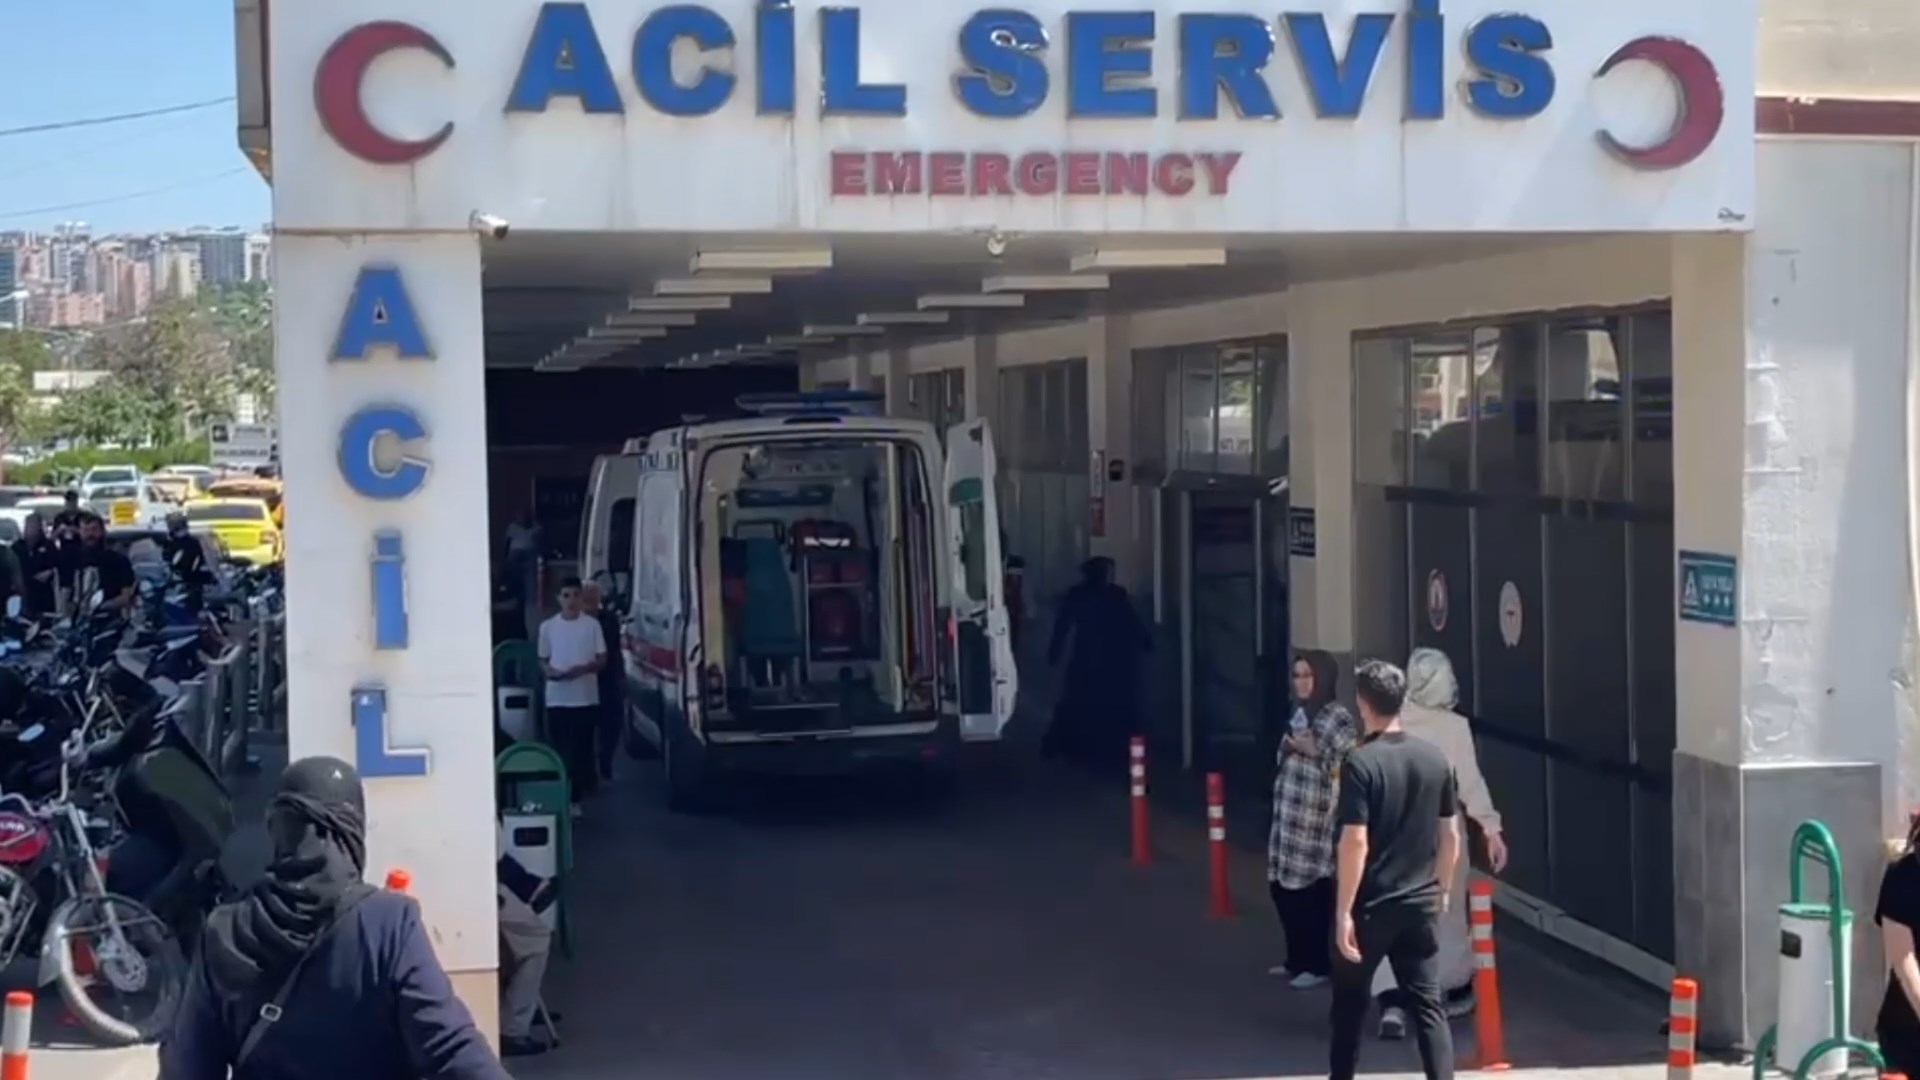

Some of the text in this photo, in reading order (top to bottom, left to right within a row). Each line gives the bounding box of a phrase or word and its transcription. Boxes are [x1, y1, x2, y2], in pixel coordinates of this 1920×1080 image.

[505, 0, 1556, 120] ACİL SERVİS
[831, 151, 1242, 196] EMERGENCY
